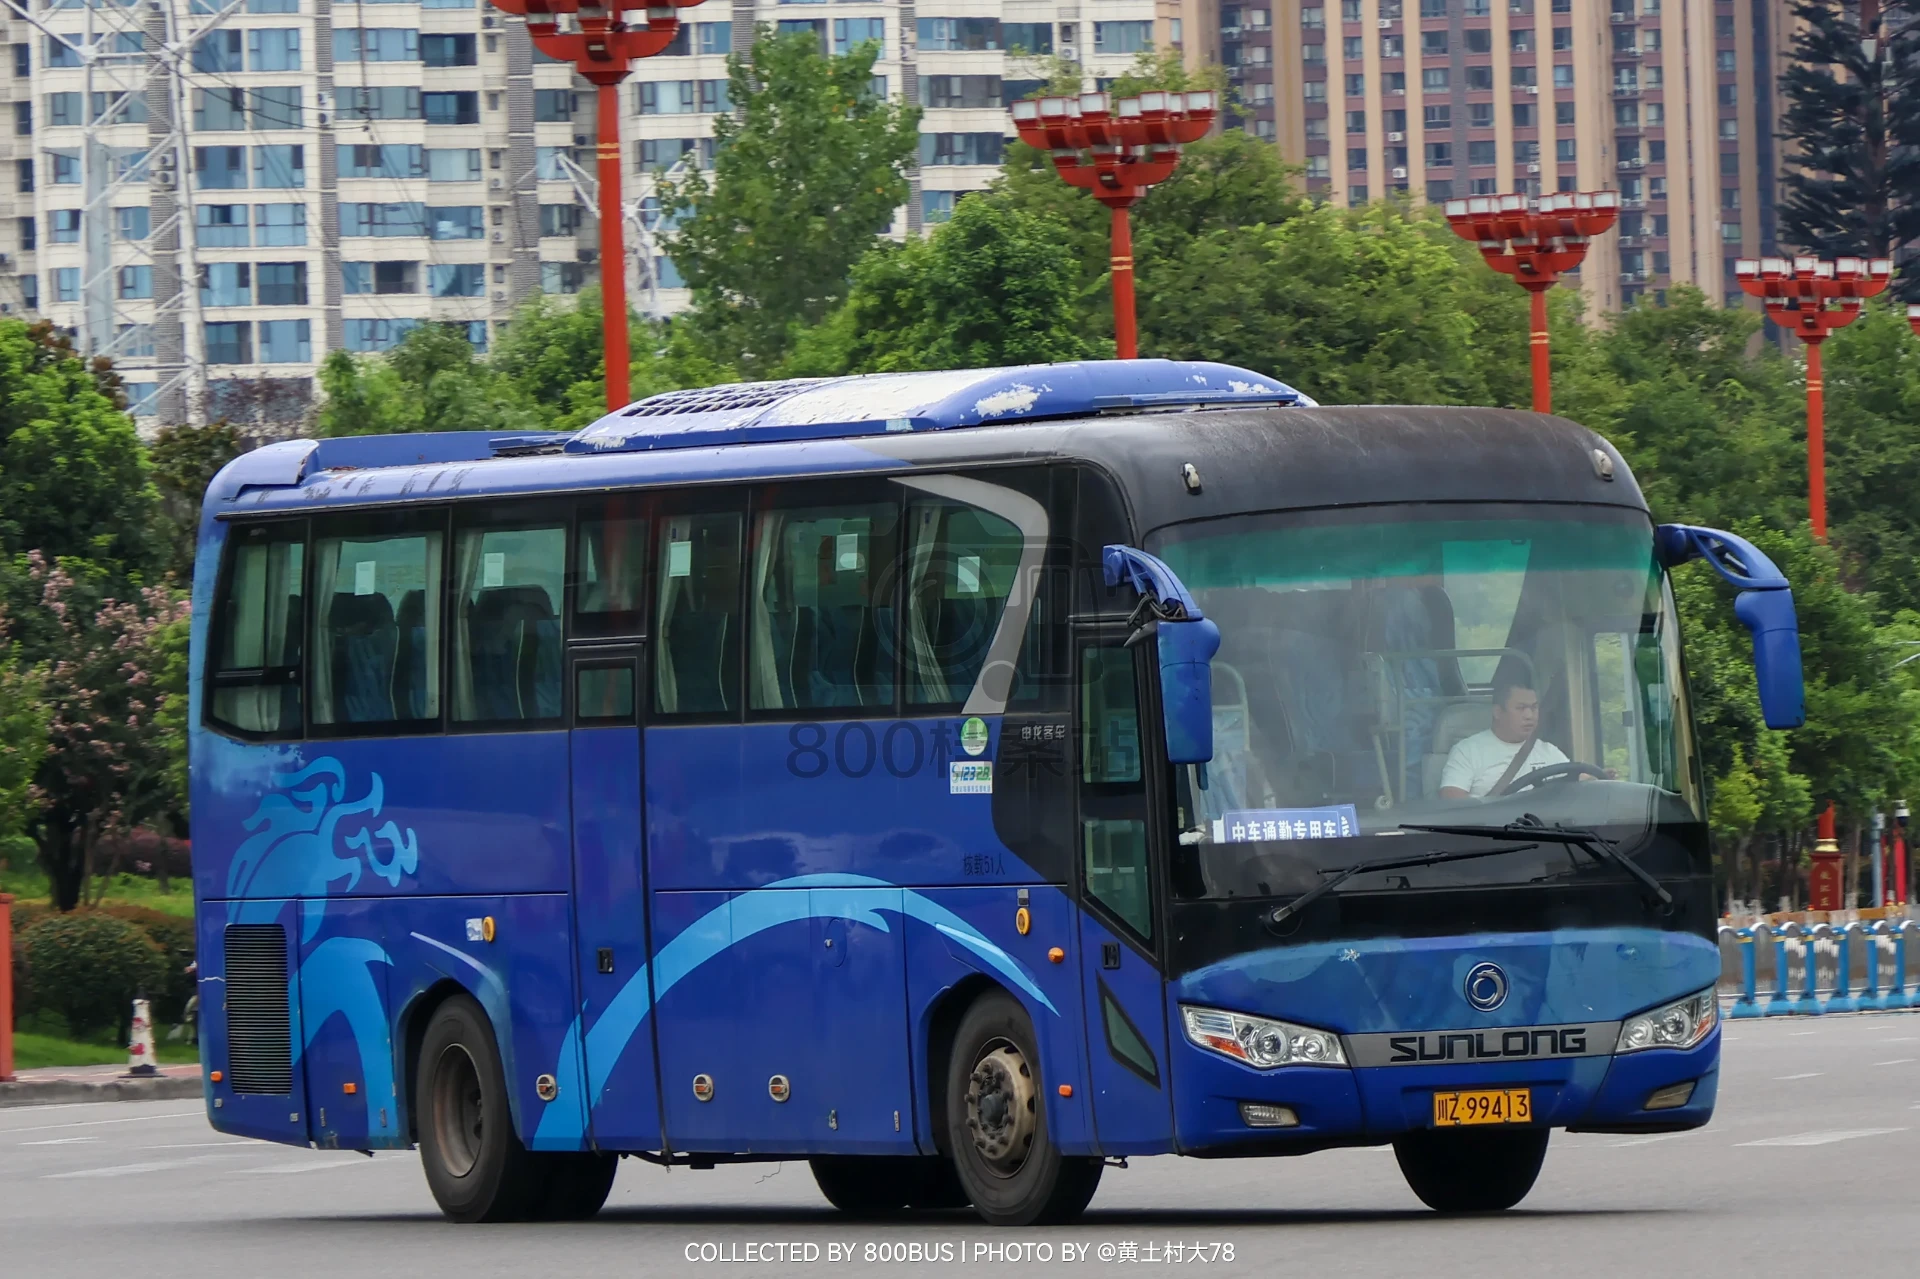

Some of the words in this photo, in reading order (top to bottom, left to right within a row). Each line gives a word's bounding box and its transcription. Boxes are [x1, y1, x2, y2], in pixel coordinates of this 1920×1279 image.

[1021, 724, 1066, 740] 申龙客车
[1232, 819, 1337, 843] 中车通勤专用车
[1390, 1028, 1586, 1063] SUNLONG
